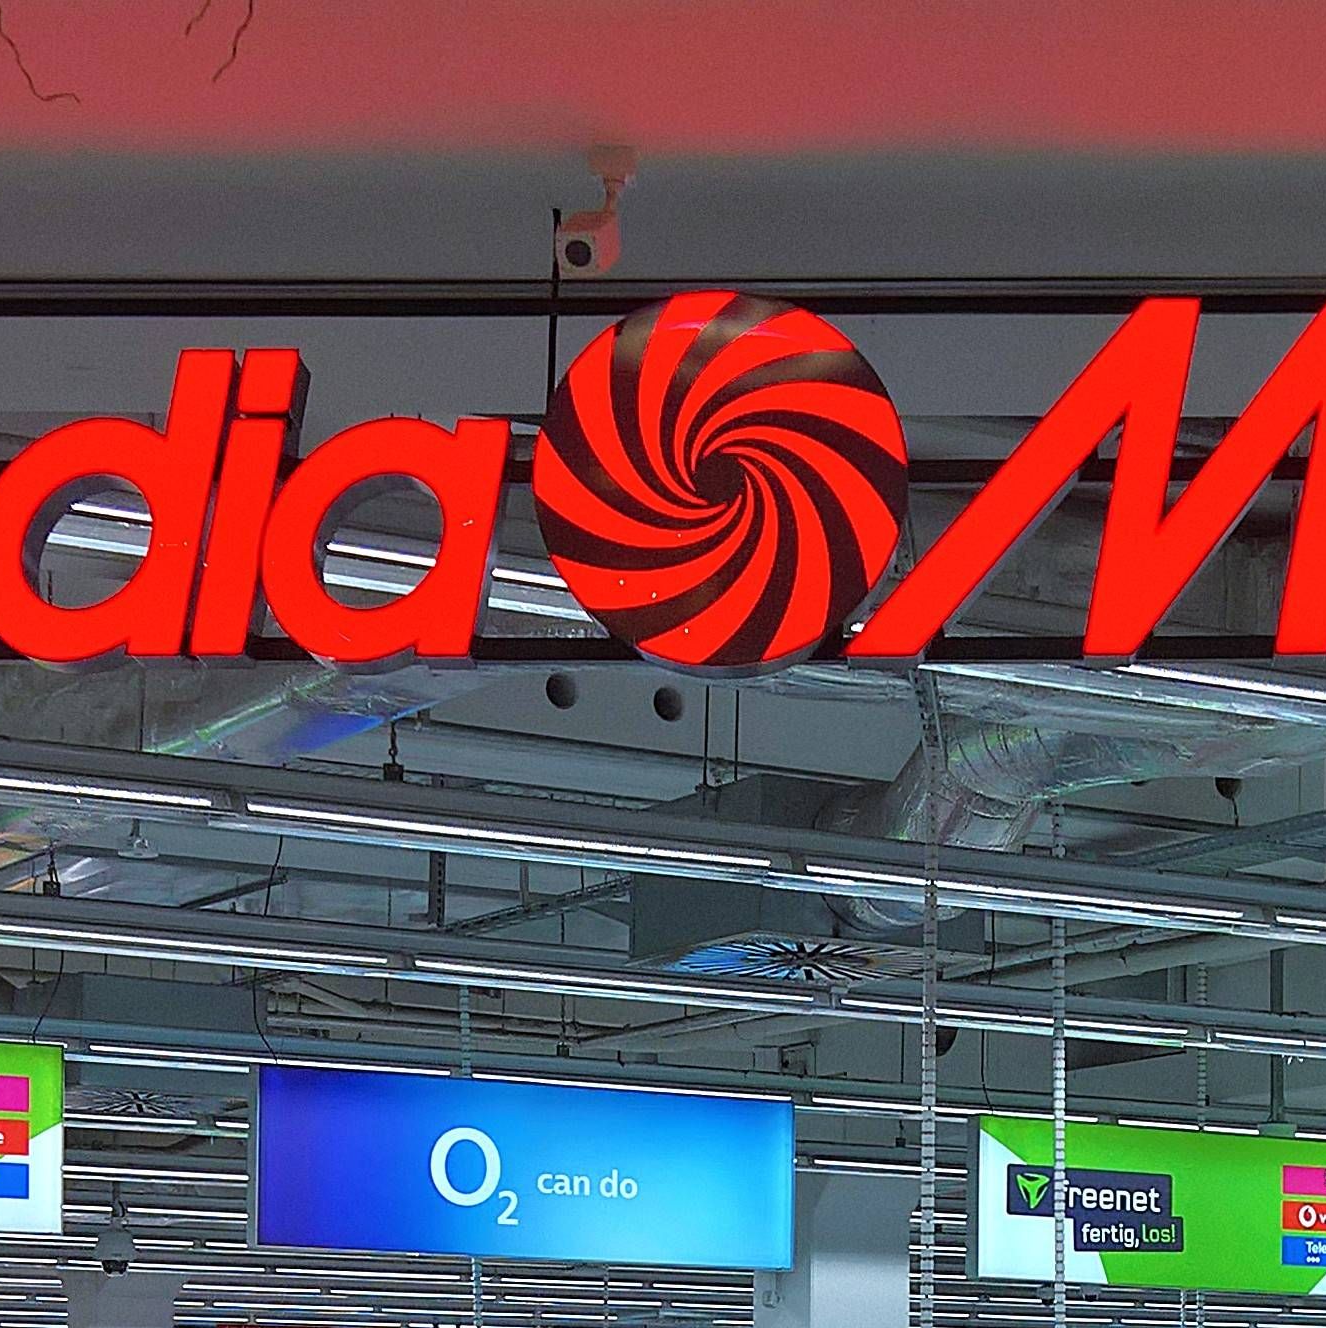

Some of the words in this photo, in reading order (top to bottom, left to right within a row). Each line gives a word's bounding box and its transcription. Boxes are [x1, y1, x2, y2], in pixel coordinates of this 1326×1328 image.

[537, 1170, 591, 1198] can
[600, 1168, 638, 1199] do
[1081, 1223, 1139, 1249] fertig,
[1142, 1223, 1176, 1243] los!
